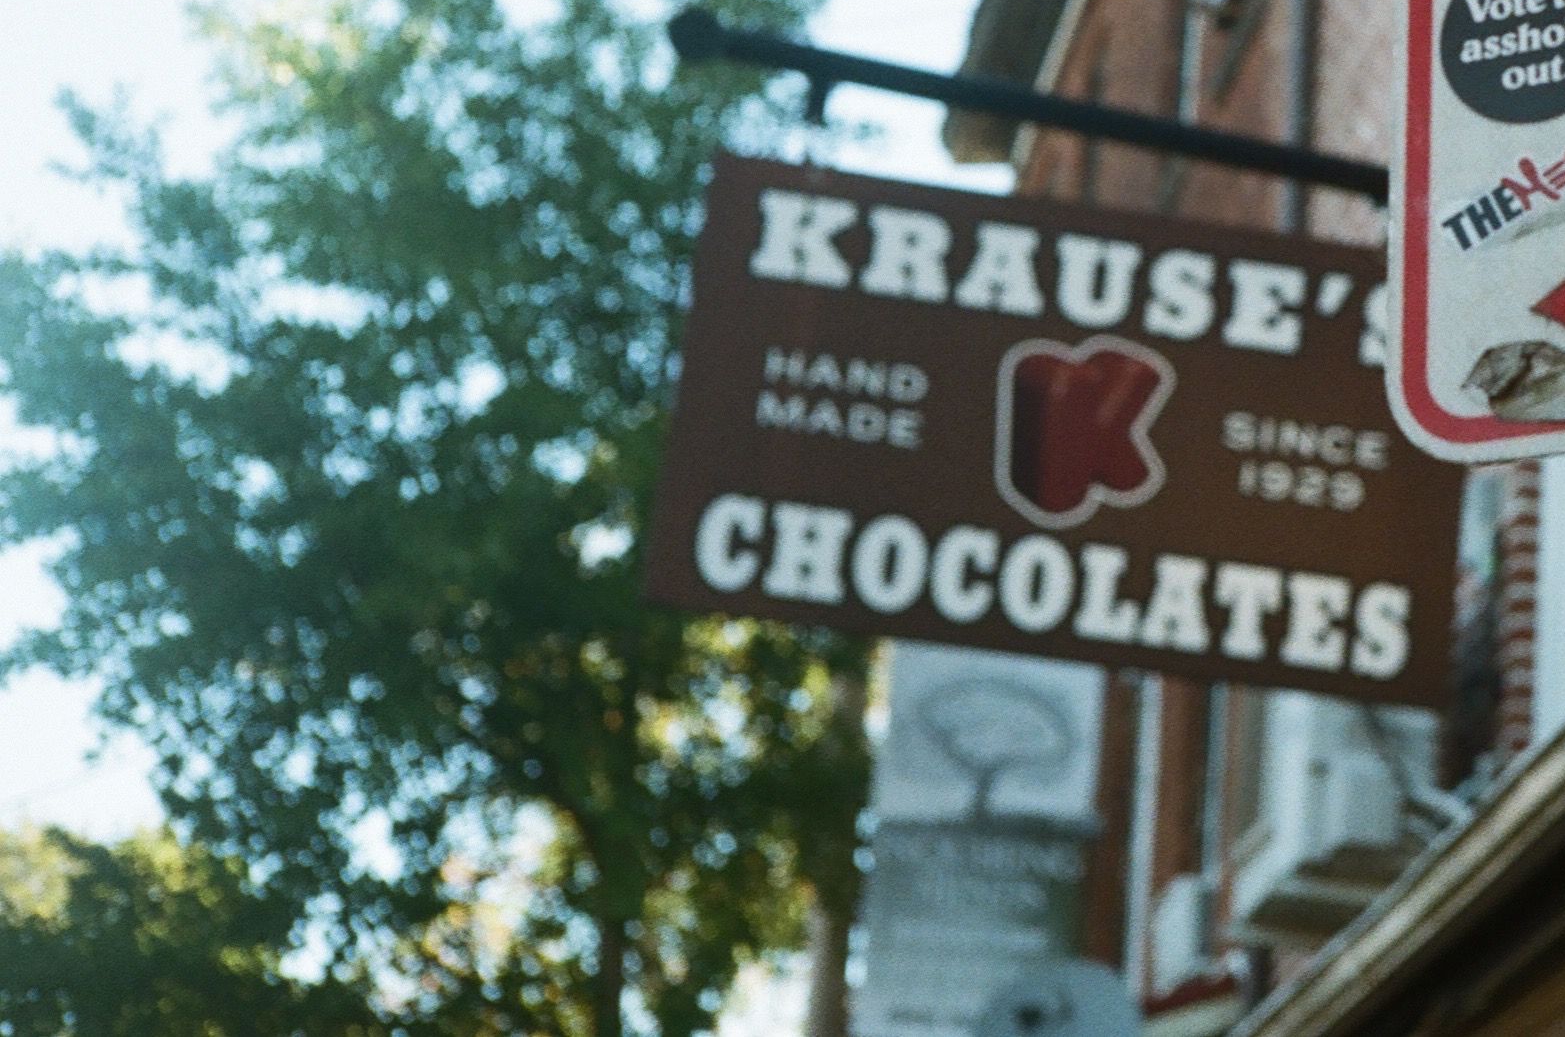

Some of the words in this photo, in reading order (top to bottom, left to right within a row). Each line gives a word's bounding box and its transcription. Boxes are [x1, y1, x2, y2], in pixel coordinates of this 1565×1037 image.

[764, 346, 929, 402] HAND
[755, 390, 924, 450] MADE
[1222, 411, 1390, 471] SINCE
[1238, 460, 1366, 512] 1929
[696, 494, 1411, 680] CHOCOLATES
